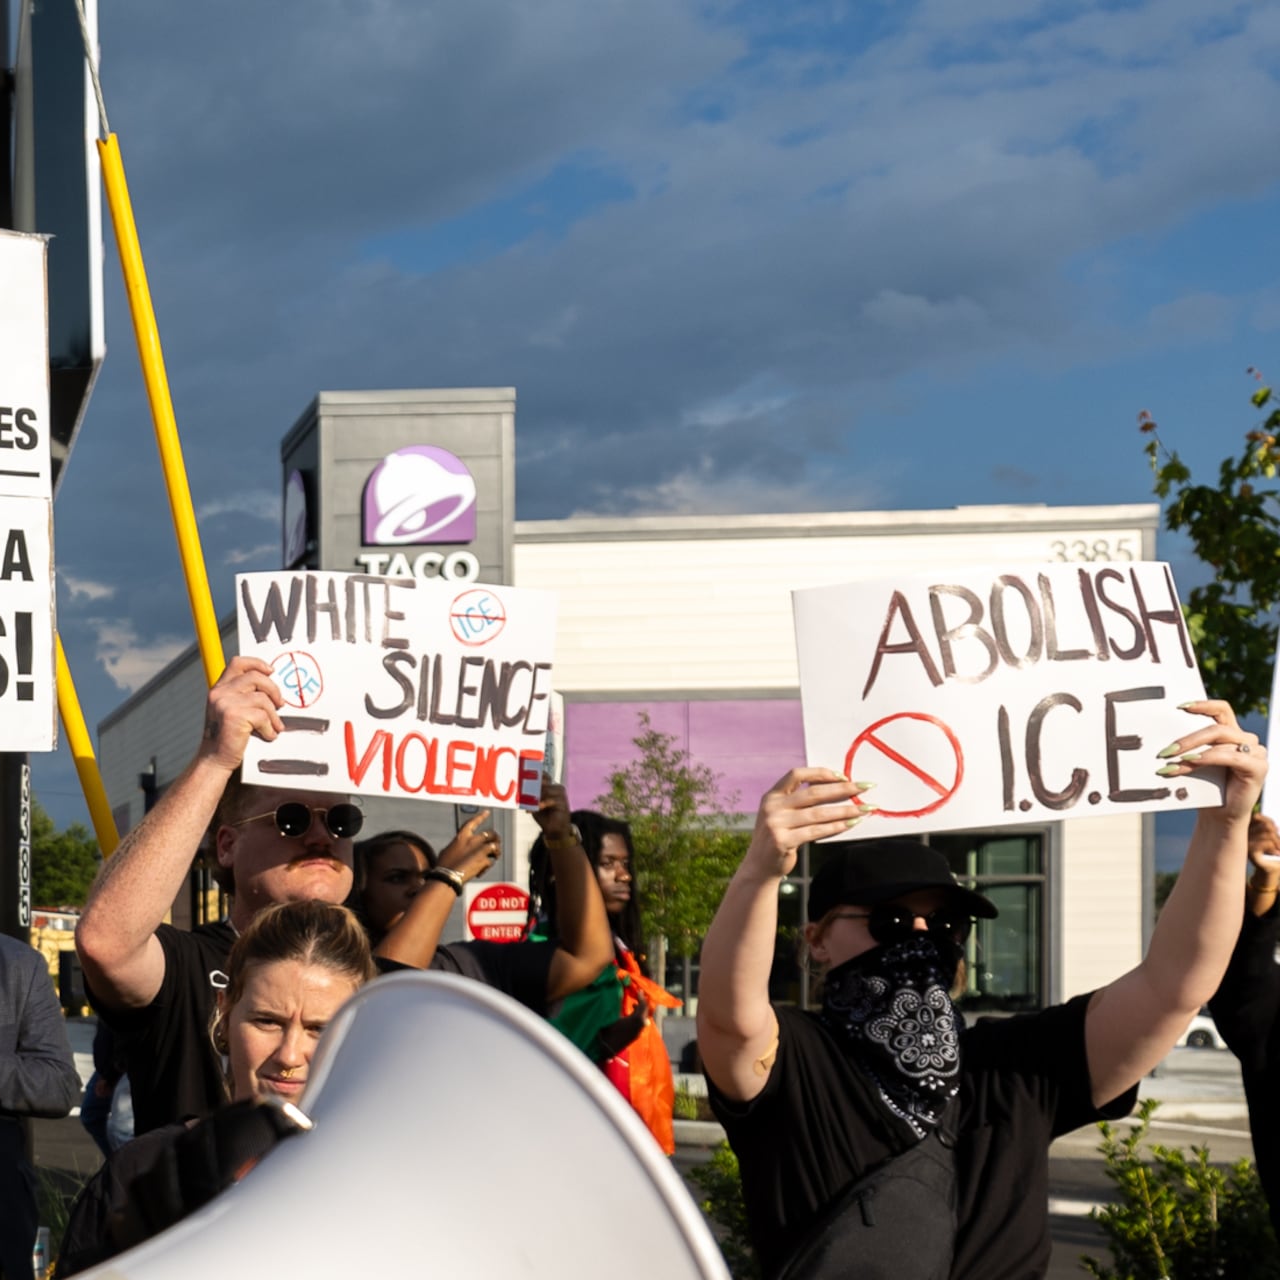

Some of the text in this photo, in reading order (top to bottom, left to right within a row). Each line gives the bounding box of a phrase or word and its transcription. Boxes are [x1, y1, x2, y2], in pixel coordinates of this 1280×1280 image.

[360, 551, 480, 583] TACO
[1049, 539, 1133, 562] 3385
[241, 574, 416, 649] WHITE
[456, 597, 499, 638] ICE
[862, 566, 1194, 700] ABOLISH
[278, 661, 319, 698] ICE
[365, 650, 552, 735] SILENCE
[344, 720, 544, 806] VIOLENCE
[998, 686, 1188, 812] I.C.E.
[480, 897, 526, 909] DO NOT
[484, 927, 522, 938] ENTER
